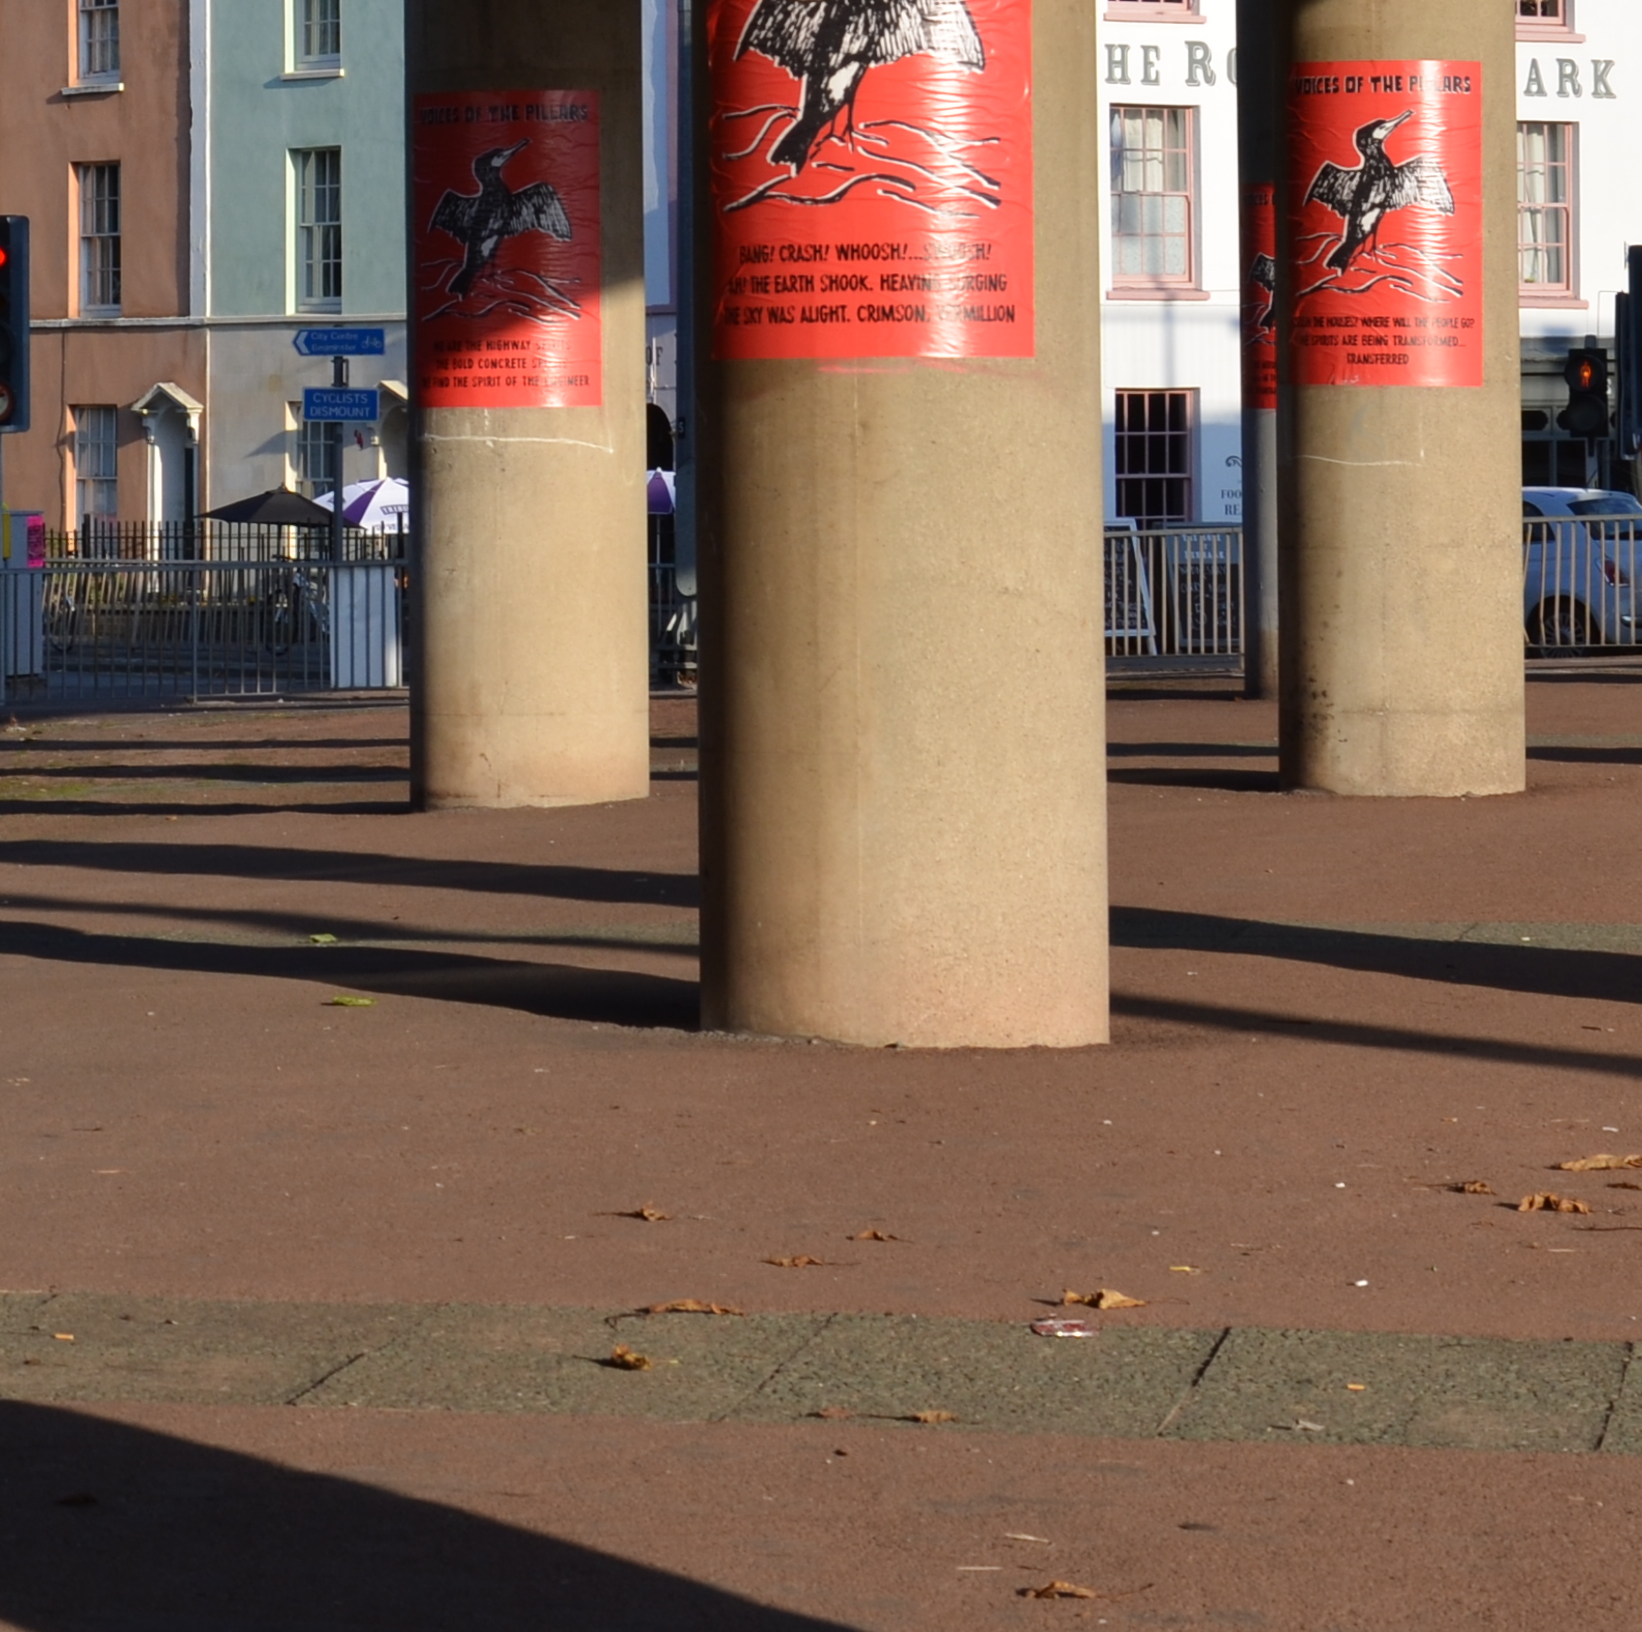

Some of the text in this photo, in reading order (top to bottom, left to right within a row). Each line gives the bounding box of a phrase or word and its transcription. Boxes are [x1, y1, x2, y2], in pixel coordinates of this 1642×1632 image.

[1294, 74, 1472, 95] VOICES OF THE PIARS
[420, 104, 589, 124] VOICES OF THE PILLARS
[740, 246, 774, 264] BANG!
[779, 244, 829, 263] CRASH!
[751, 276, 770, 294] THE
[775, 274, 815, 293] EARTH
[820, 273, 874, 292] SHOOK.
[948, 273, 1007, 292] RGING
[743, 306, 762, 324] SKY
[767, 305, 794, 324] WAS
[800, 303, 851, 323] ALIGHT.
[937, 303, 1016, 323] MILLION
[1361, 316, 1390, 328] WHERE
[1392, 316, 1411, 328] WILL
[311, 332, 359, 342] City Centre
[1342, 334, 1358, 346] ARE
[1361, 334, 1389, 346] BEING
[465, 340, 481, 351] THE
[486, 339, 531, 351] HIGHWAY
[478, 357, 527, 369] CONCRETE
[1347, 353, 1409, 365] TRANSFERRED
[453, 376, 468, 388] THE
[472, 376, 501, 388] SPIRIT
[505, 376, 517, 387] OF
[522, 375, 539, 387] THE
[544, 375, 590, 387] ENEER
[313, 392, 368, 404] CYCLISTS
[310, 406, 371, 418] DISMOUNT
